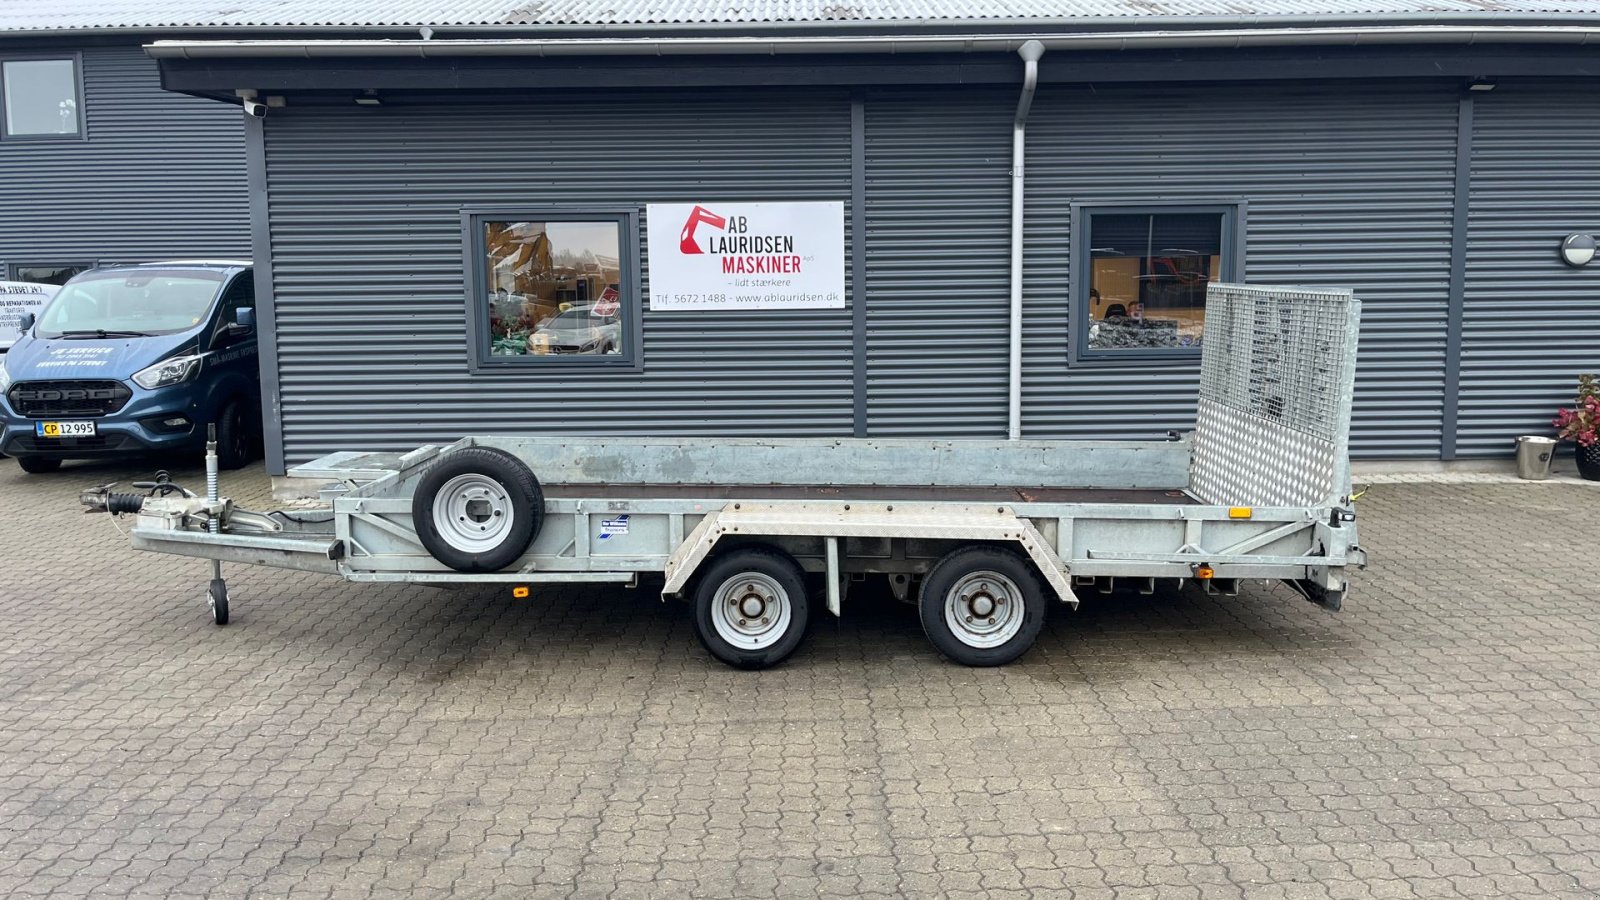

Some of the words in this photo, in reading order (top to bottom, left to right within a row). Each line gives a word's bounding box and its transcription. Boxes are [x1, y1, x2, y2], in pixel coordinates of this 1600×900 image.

[728, 216, 748, 234] AB
[709, 235, 793, 254] LAURIDSEN
[722, 255, 801, 274] MASKINER
[735, 278, 749, 287] lidt
[751, 278, 791, 287] stærkere
[674, 294, 699, 304] 5672
[702, 293, 726, 303] 1488
[735, 292, 839, 303] www.ablauridsen.dk
[43, 424, 58, 434] CP
[60, 424, 72, 434] 12
[74, 423, 93, 433] 995
